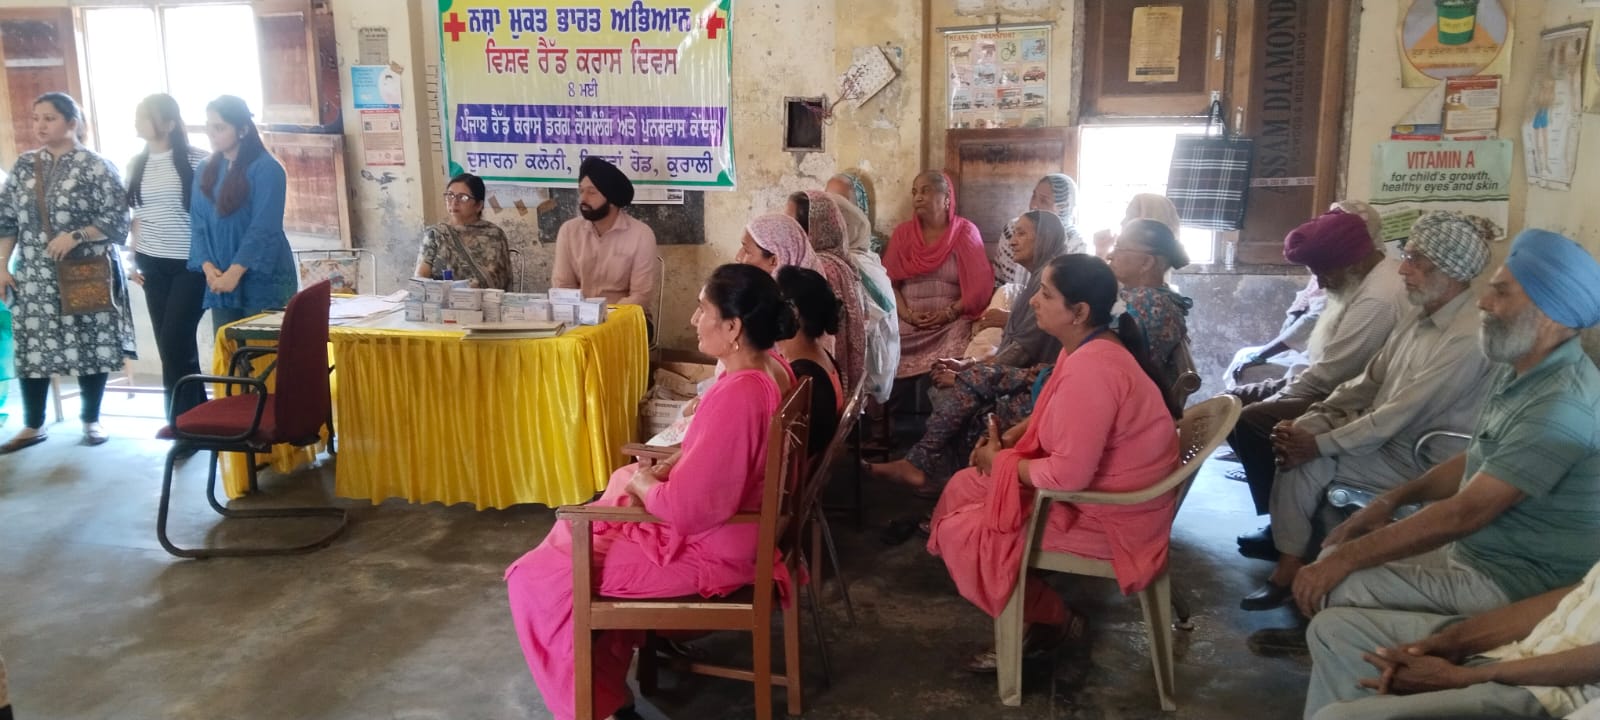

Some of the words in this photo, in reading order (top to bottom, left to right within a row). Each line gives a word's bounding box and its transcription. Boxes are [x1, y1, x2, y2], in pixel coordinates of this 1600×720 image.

[467, 8, 501, 35] ਨਸ਼ਾ
[508, 8, 548, 39] ਮੁਕਤ
[556, 8, 601, 33] ਭਾਰਤ
[610, 0, 691, 33] ਅਭਿਆਨ
[485, 38, 529, 74] ਵਿਸ਼ਵ
[537, 37, 569, 74] ਰੈੱਡ
[576, 48, 622, 74] ਕਰਾਸ
[630, 38, 678, 75] ਦਿਵਸ
[1263, 0, 1297, 111] DIAMOND
[568, 81, 576, 98] 8
[579, 77, 598, 98] ਮਈ
[460, 108, 488, 135] ਪੰਜਾਬ
[491, 108, 510, 135] ਰੈੱਡ
[513, 116, 542, 136] ਕਰਾਸ
[544, 110, 571, 136] ਡਰੱਗ
[617, 111, 637, 137] ਅਤੇ
[524, 148, 572, 175] ਕਲੋਨੀ,
[629, 149, 660, 177] ਰੋਡ,
[666, 151, 714, 178] ਕੁਰਾਲੀ
[1407, 151, 1462, 169] VITAMIN
[1465, 150, 1475, 168] A
[1381, 182, 1421, 194] healthy
[1424, 183, 1450, 193] eyes
[1452, 181, 1474, 191] and
[1475, 181, 1499, 191] skin
[1391, 171, 1407, 181] for
[1409, 171, 1447, 182] child's
